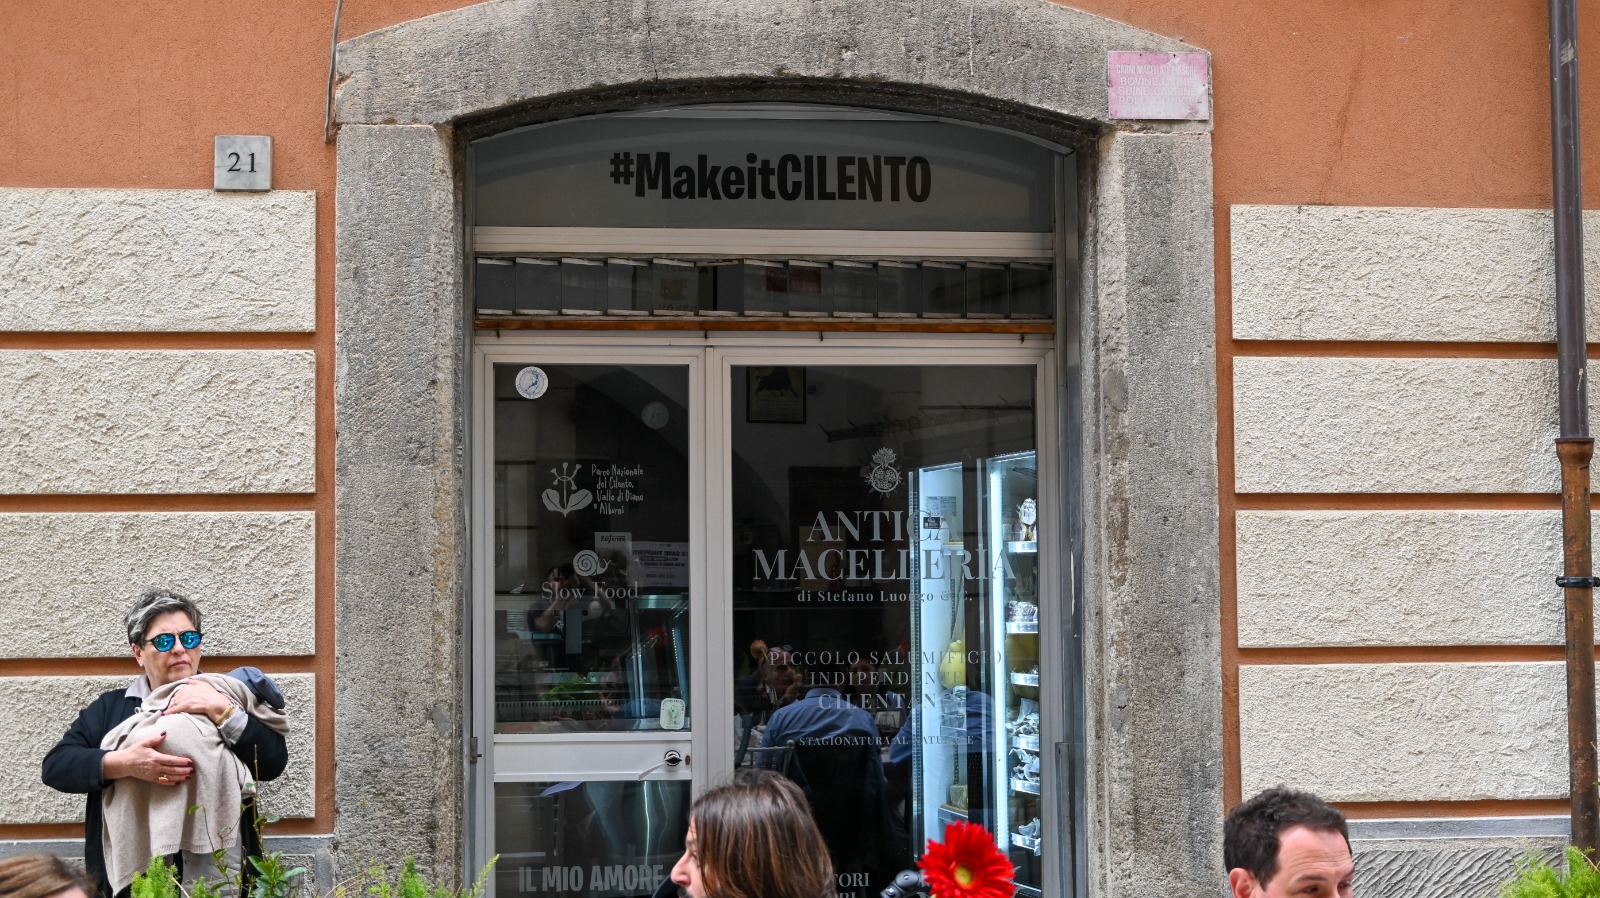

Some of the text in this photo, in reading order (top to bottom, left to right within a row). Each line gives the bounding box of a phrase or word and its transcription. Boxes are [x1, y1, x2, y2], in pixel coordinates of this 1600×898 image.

[1120, 76, 1159, 86] BOVINE
[1118, 86, 1151, 96] SUINE
[227, 152, 257, 173] 21
[609, 151, 932, 203] #MakeitCILENTO
[591, 463, 644, 477] Parco Nazionale
[596, 477, 607, 490] del
[596, 489, 644, 502] Valle di Diano
[599, 502, 625, 515] Alburni
[806, 510, 962, 542] ANTICA
[752, 549, 1017, 580] MACELLERIA
[541, 581, 638, 599] Slow Food
[797, 590, 811, 602] di
[817, 590, 874, 602] Stefano
[770, 651, 861, 666] PICCOLO
[811, 671, 963, 686] INDIPENDNTE
[819, 693, 957, 710] CILENTN
[799, 735, 890, 747] STAGIONATURA
[893, 736, 909, 747] AL
[518, 865, 664, 893] IL MIO AMORE
